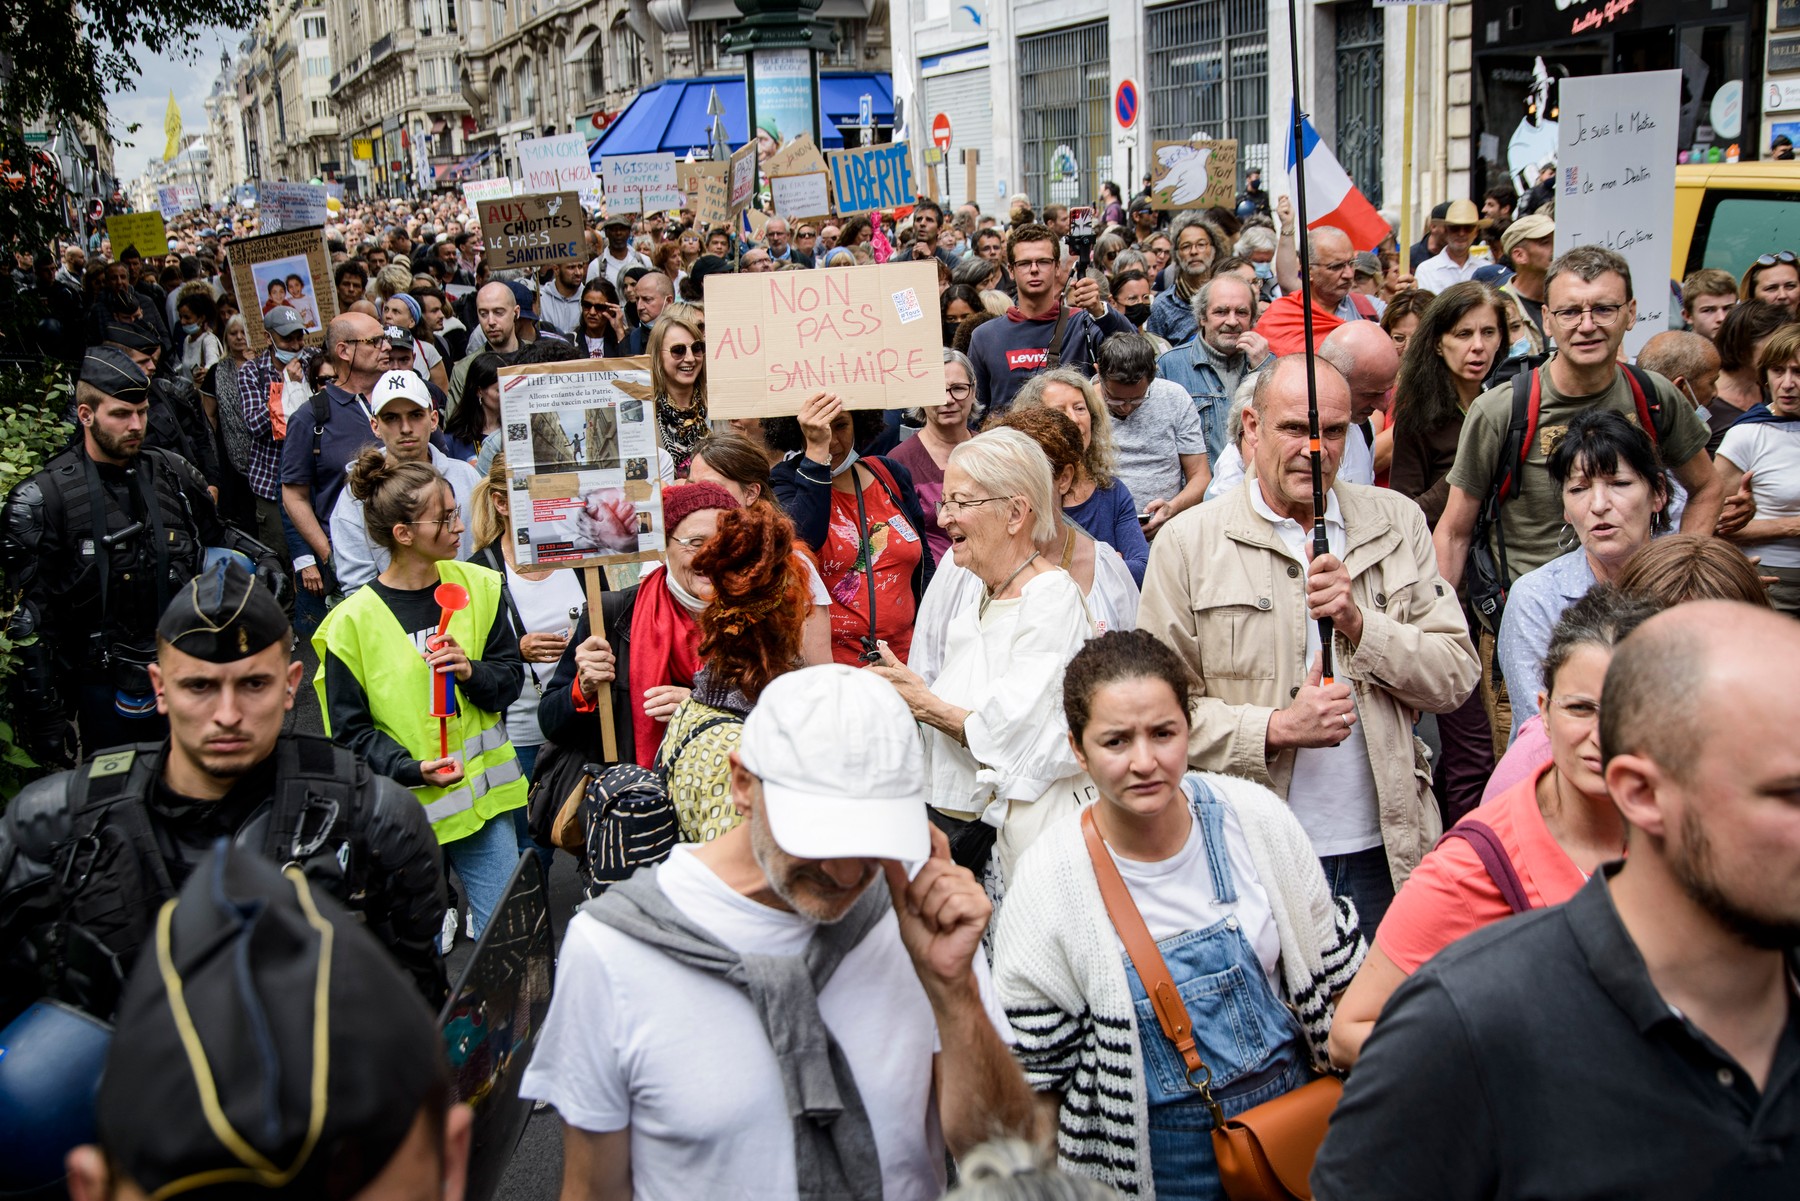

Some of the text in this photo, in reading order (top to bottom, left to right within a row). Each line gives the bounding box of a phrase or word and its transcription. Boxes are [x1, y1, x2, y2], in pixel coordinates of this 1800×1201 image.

[862, 102, 869, 122] P
[1568, 113, 1587, 147] Je
[1590, 124, 1610, 140] suis
[1615, 112, 1623, 135] le
[525, 139, 588, 161] MON CORPS
[614, 161, 671, 176] AGISSONS
[1213, 166, 1233, 180] TON
[529, 167, 593, 189] MON CHOIX
[623, 174, 660, 184] CONTRE
[1582, 171, 1594, 195] de
[1600, 179, 1617, 191] mon
[607, 184, 617, 193] LE
[623, 184, 661, 193] LIQUIDE
[1207, 183, 1234, 199] NOM
[608, 198, 620, 207] LA
[624, 194, 678, 206] DICTATURE
[488, 202, 528, 224] AUX
[503, 215, 572, 236] CHIOTTES
[489, 230, 550, 249] LE PASS
[769, 273, 851, 315] NON
[284, 310, 297, 321] NY
[900, 308, 920, 318] #Tous
[714, 304, 882, 360] AU PASS
[388, 375, 406, 391] NY
[526, 371, 619, 387] THE EPOCH TIMES
[528, 392, 550, 400] Allons
[550, 390, 575, 399] enfants
[592, 388, 614, 397] Patrie,
[528, 401, 535, 409] le
[535, 401, 550, 410] jour
[561, 399, 582, 407] vaccin
[592, 396, 612, 405] arrivé
[823, 559, 844, 572] fly
